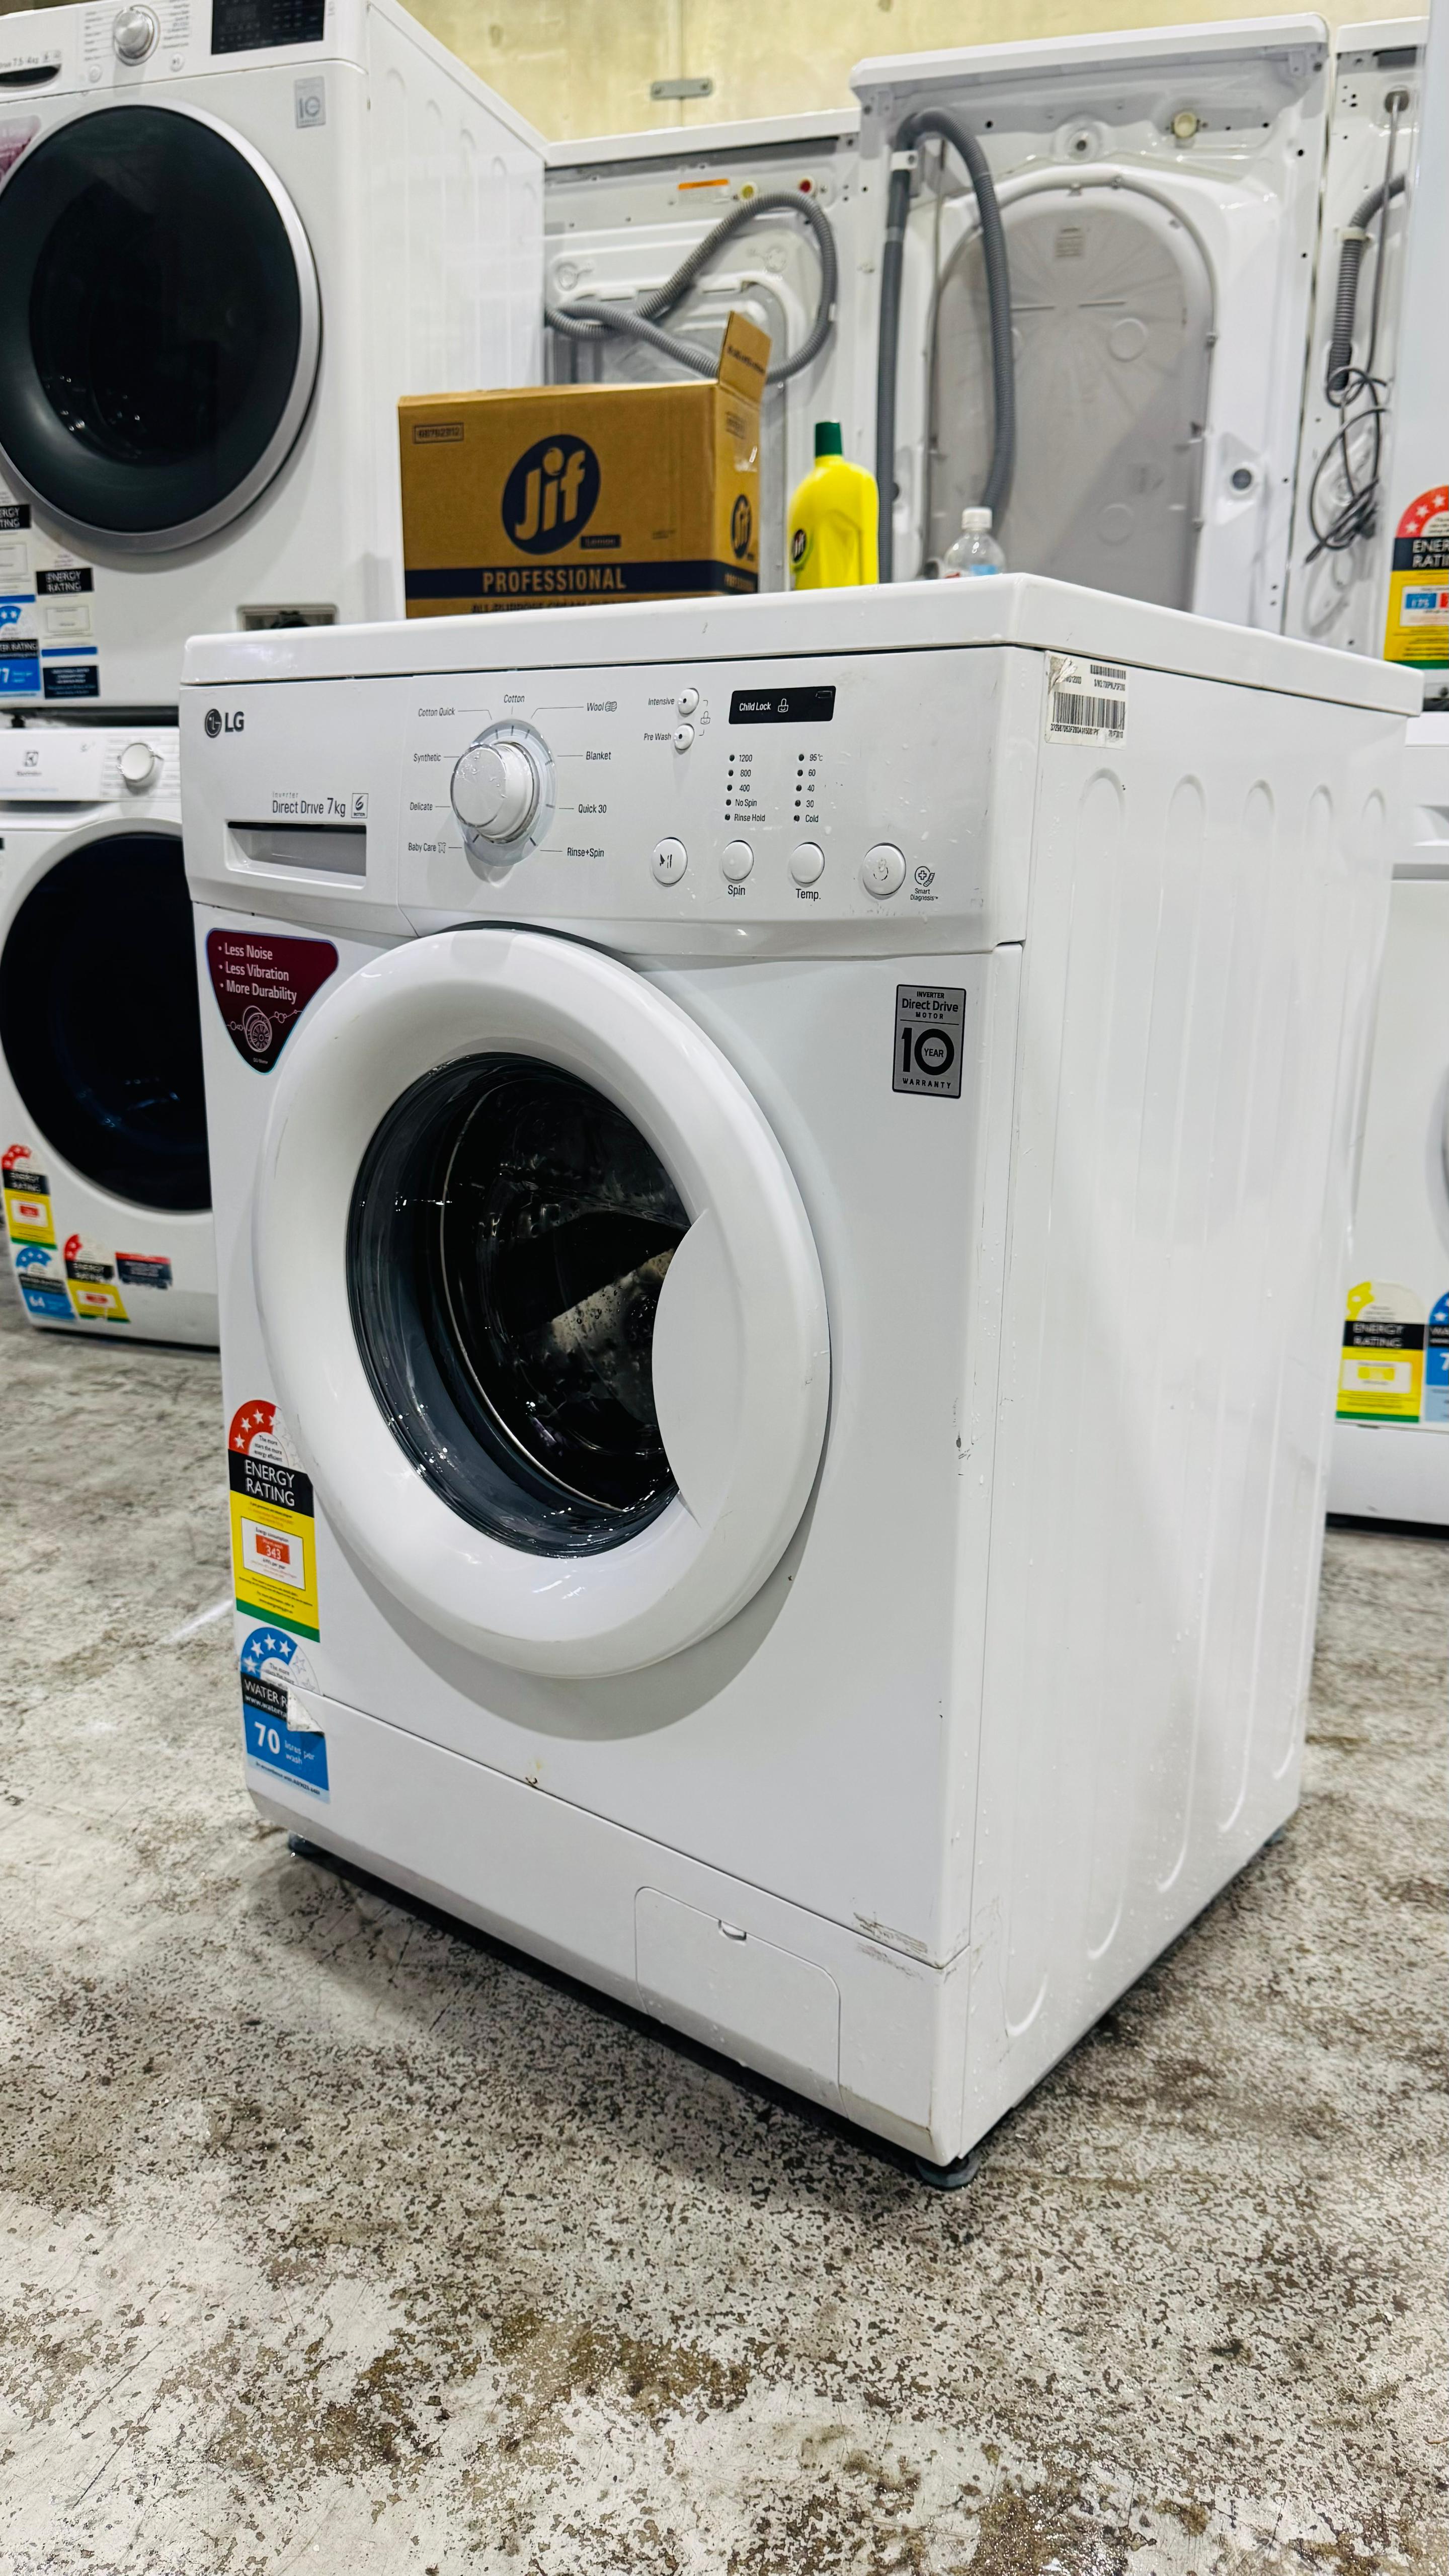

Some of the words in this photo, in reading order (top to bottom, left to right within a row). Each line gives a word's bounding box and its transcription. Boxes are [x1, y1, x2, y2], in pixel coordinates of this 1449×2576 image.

[46, 571, 81, 582] ENERGY
[482, 568, 627, 593] PROFESSIONAL
[46, 581, 82, 592] RATING
[504, 694, 525, 703] Cotton
[648, 697, 675, 705] Intensive
[418, 708, 438, 716] Cotton
[439, 707, 455, 716] Quick
[587, 702, 604, 711] Wool
[739, 702, 755, 711] Child
[756, 702, 771, 711] Lock
[225, 711, 245, 733] LG
[655, 733, 671, 741] Wash
[414, 753, 441, 762] Synthetic
[586, 751, 611, 760] Blanket
[739, 754, 753, 763] 1200
[740, 769, 751, 777] 800
[808, 769, 816, 777] 60
[739, 784, 750, 792] 400
[808, 784, 815, 793] 40
[272, 800, 298, 814] Direct
[301, 800, 324, 814] Drive
[410, 802, 433, 811] Delicate
[579, 804, 597, 814] Quick
[598, 805, 607, 814] 30
[744, 799, 757, 809] Spin
[807, 800, 814, 808] 30
[734, 814, 751, 822] Rinse
[752, 814, 766, 822] Hold
[806, 815, 819, 823] Cold
[408, 843, 422, 853] Baby
[423, 844, 436, 852] Care
[567, 848, 604, 859] Rinse+Spin
[728, 884, 746, 897] Spin
[795, 889, 821, 902] Temp.
[224, 942, 245, 957] Less
[247, 944, 273, 960] Noise
[226, 961, 245, 976] Less
[247, 963, 289, 981] Vibration
[226, 980, 250, 995] More
[252, 983, 297, 1005] Durability
[917, 991, 944, 999] INVERTER
[902, 998, 931, 1010] Direct
[933, 1000, 958, 1012] Drive
[902, 1027, 954, 1076] 10
[924, 1048, 944, 1058] YEAR
[903, 1078, 951, 1089] WARRANTY
[245, 1459, 295, 1488] ENERGY
[246, 1477, 295, 1507] RATING
[266, 1545, 282, 1560] 343
[244, 1678, 279, 1705] WATER
[254, 1721, 281, 1755] 70
[285, 1752, 303, 1765] wash
[304, 1750, 315, 1761] per
